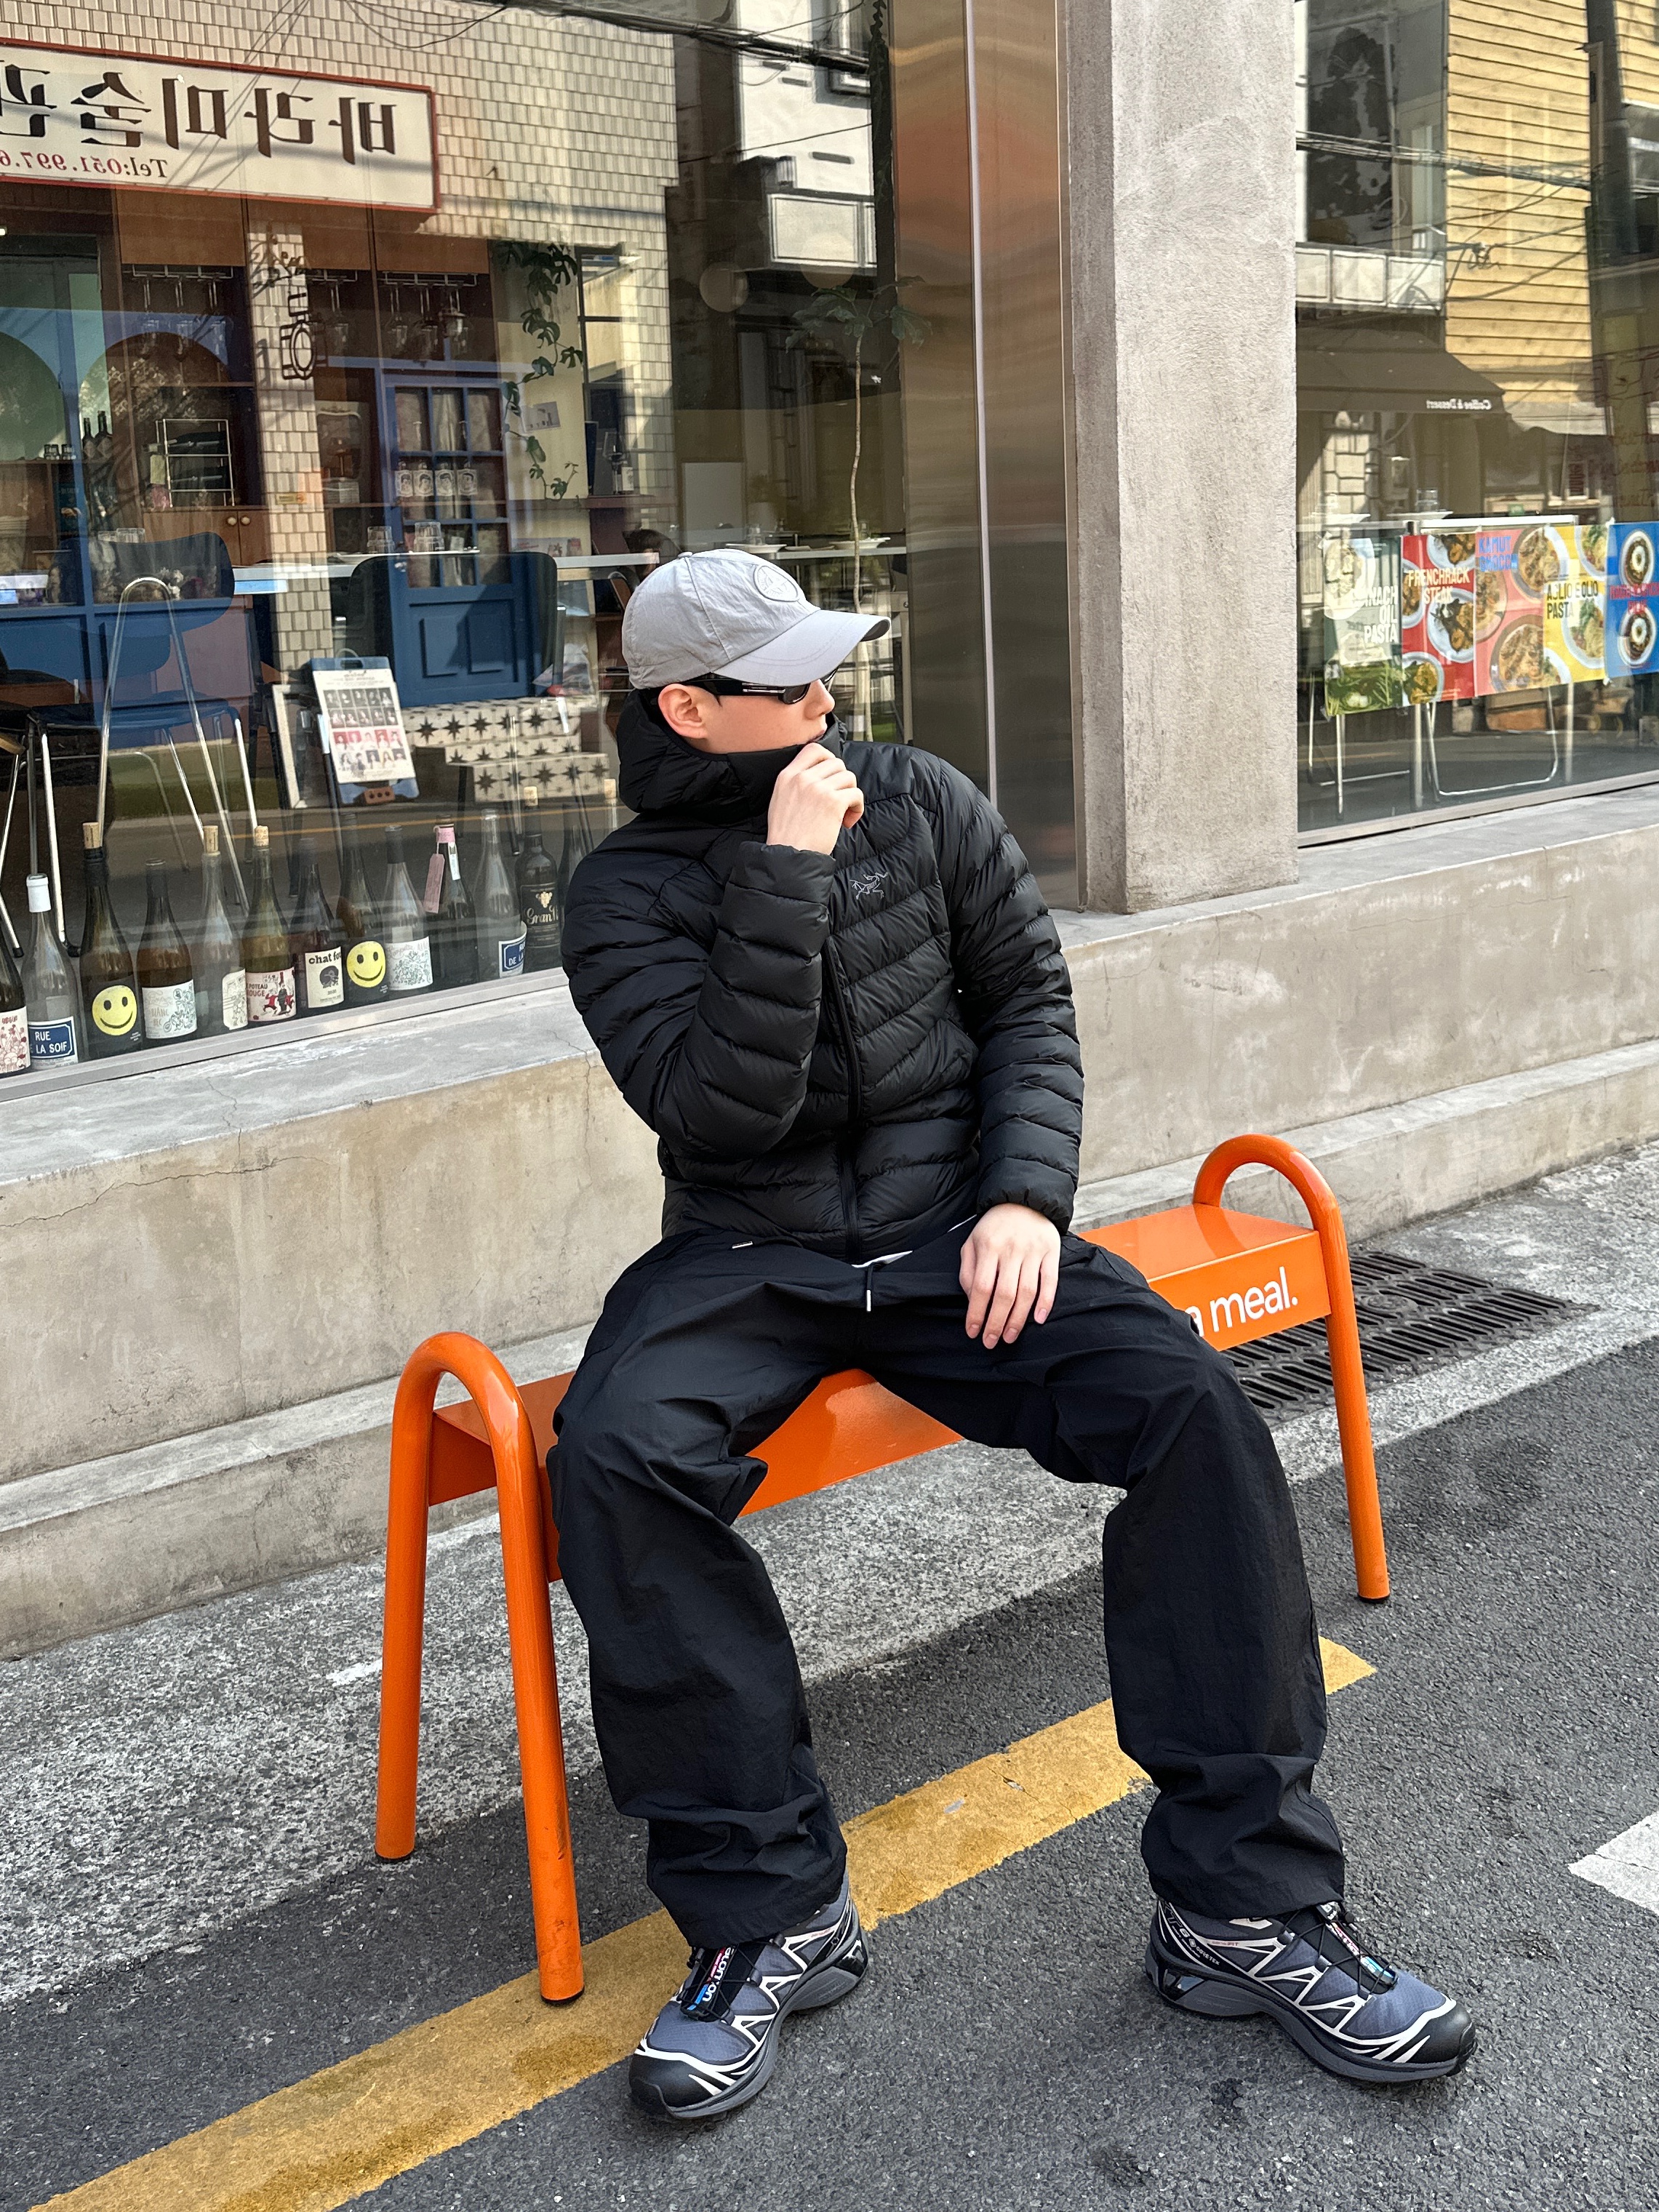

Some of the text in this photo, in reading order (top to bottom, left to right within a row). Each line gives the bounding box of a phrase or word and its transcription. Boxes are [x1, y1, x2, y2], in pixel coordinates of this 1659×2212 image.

[1479, 554, 1519, 572] GNOCC
[1350, 585, 1398, 608] SINACH
[1423, 586, 1453, 604] STEAK
[1581, 580, 1599, 598] OLIO
[1379, 604, 1398, 625] OIL
[1547, 601, 1574, 620] PASTA
[1364, 622, 1398, 644] PASTA
[308, 951, 342, 965] chat fo
[508, 957, 516, 966] DE
[35, 1031, 51, 1041] RUE
[36, 1044, 47, 1054] LA
[49, 1041, 68, 1054] SOIF
[1210, 1266, 1298, 1332] meal.
